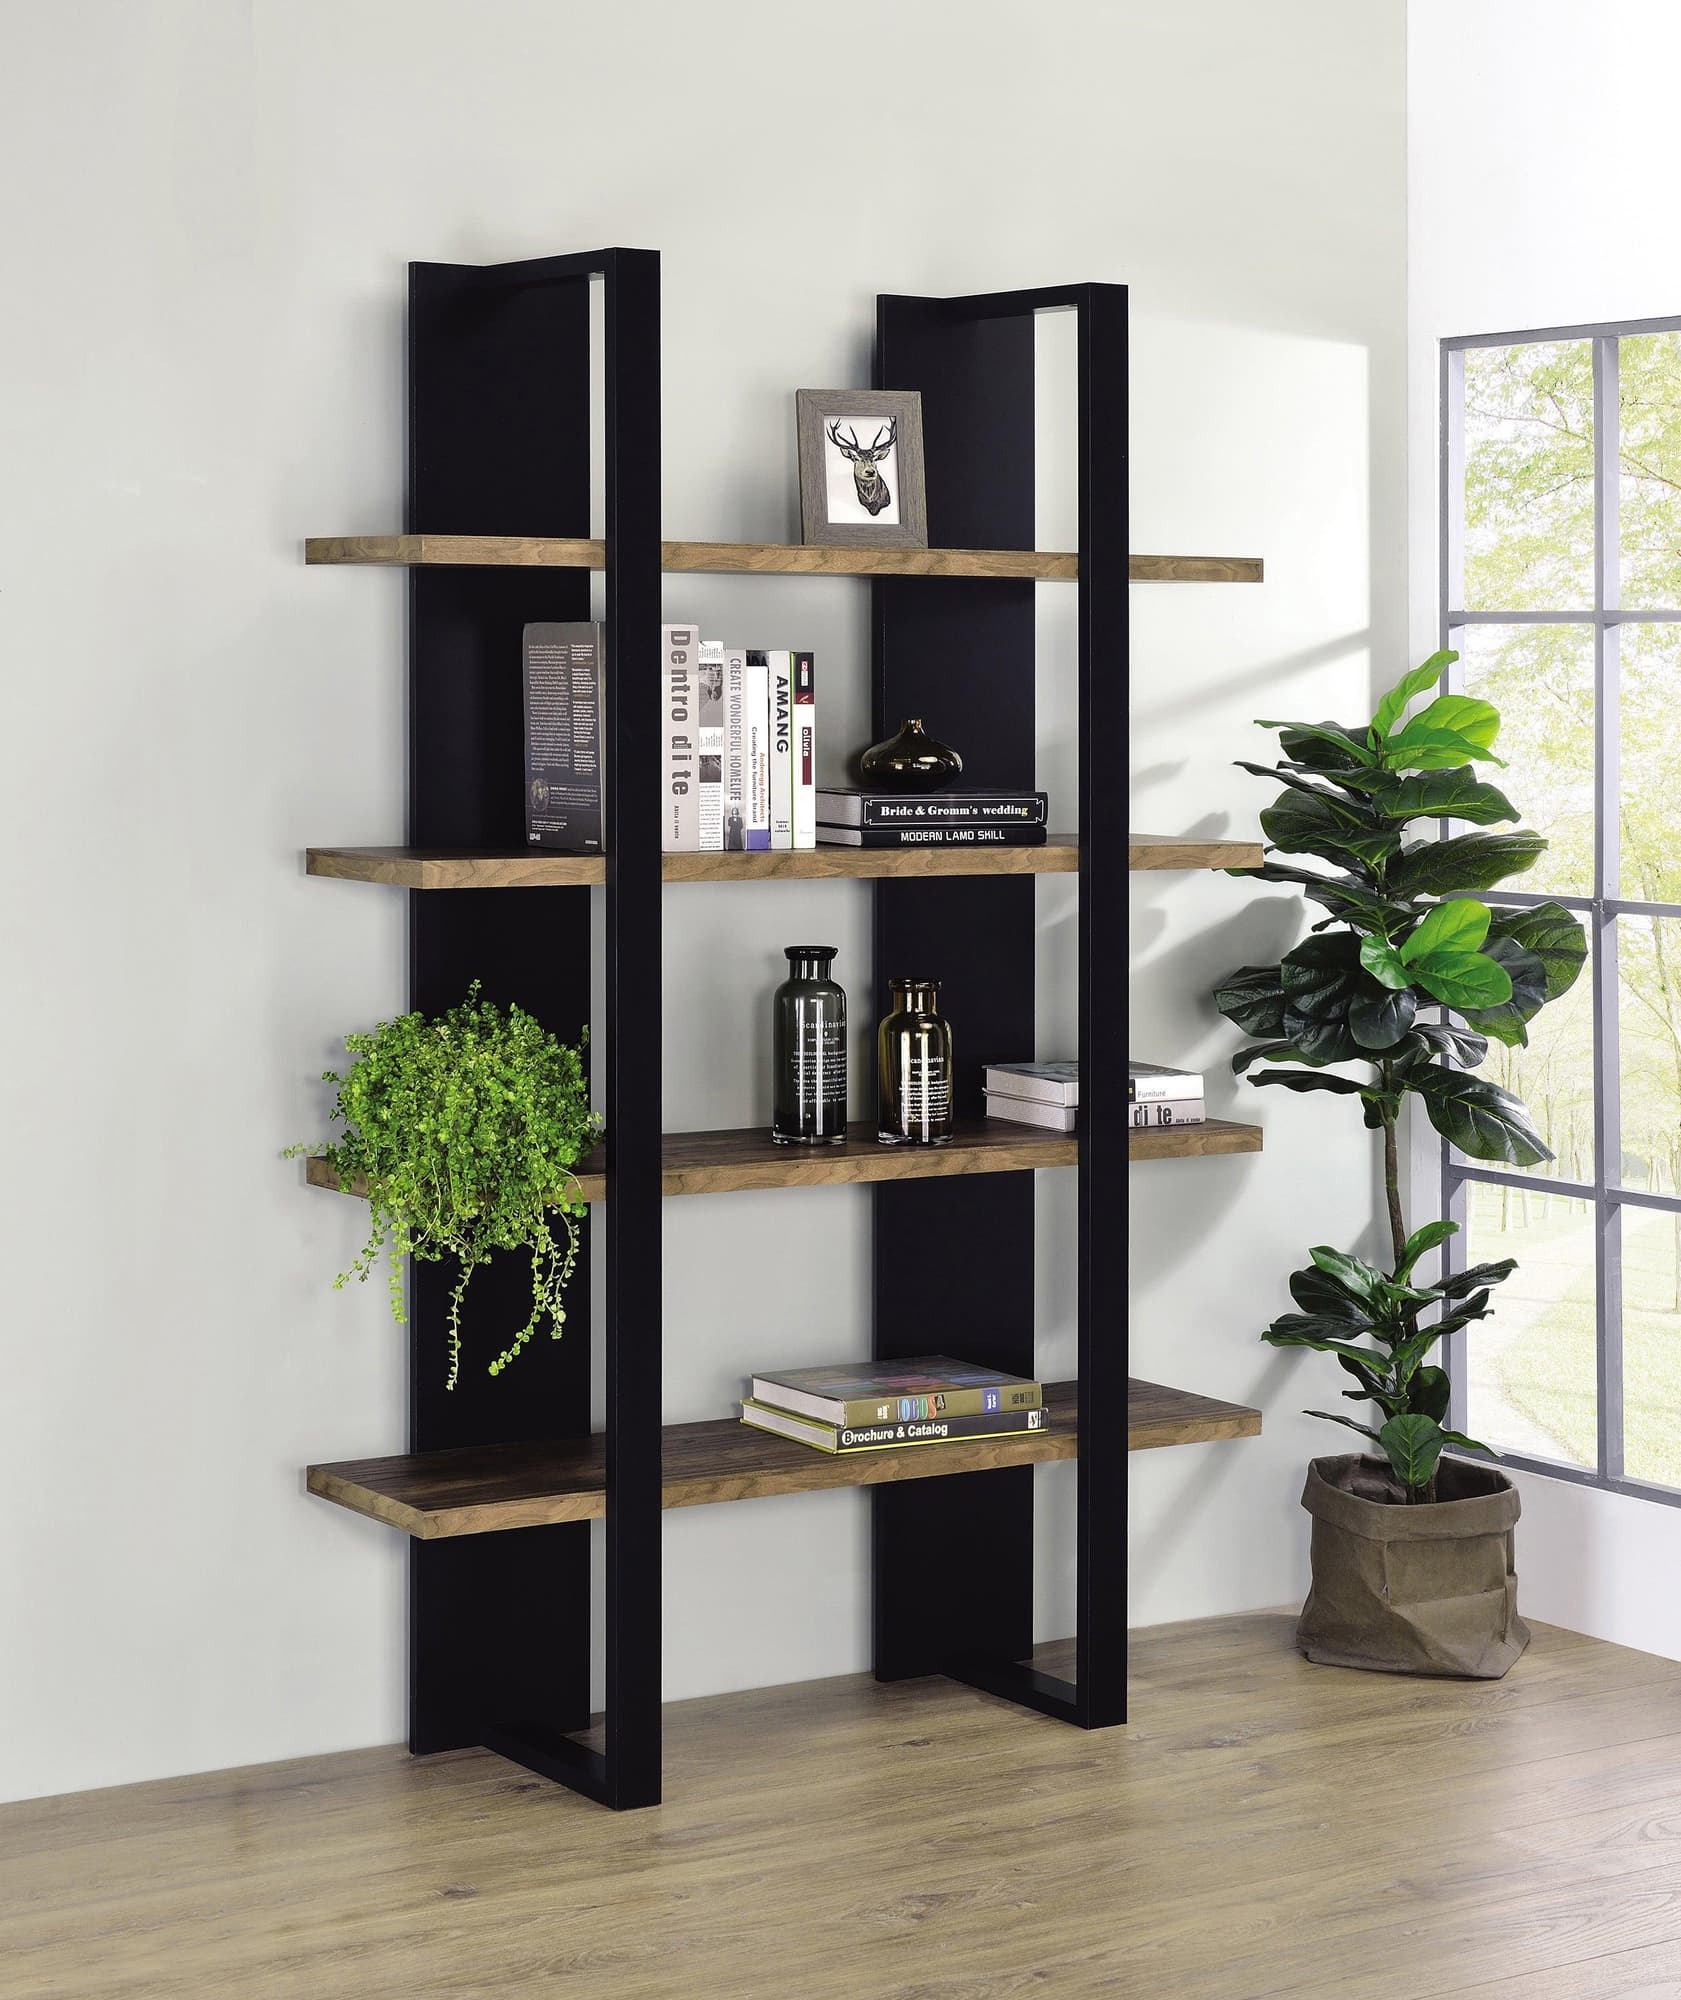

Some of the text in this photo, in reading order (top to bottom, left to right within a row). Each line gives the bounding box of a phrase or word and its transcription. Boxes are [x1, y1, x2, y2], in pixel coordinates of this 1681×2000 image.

[670, 630, 692, 796] Dentro di te
[776, 675, 789, 754] AMANG
[729, 658, 742, 801] CREATE WONDERFUL HOMELIFE
[802, 728, 810, 757] olivia
[880, 805, 1028, 817] Bride & Gromm's wedding
[900, 831, 943, 842] MODERN
[977, 829, 1006, 840] SKILL
[1133, 1104, 1172, 1127] di te
[841, 1422, 948, 1446] Brochure & Catalog
